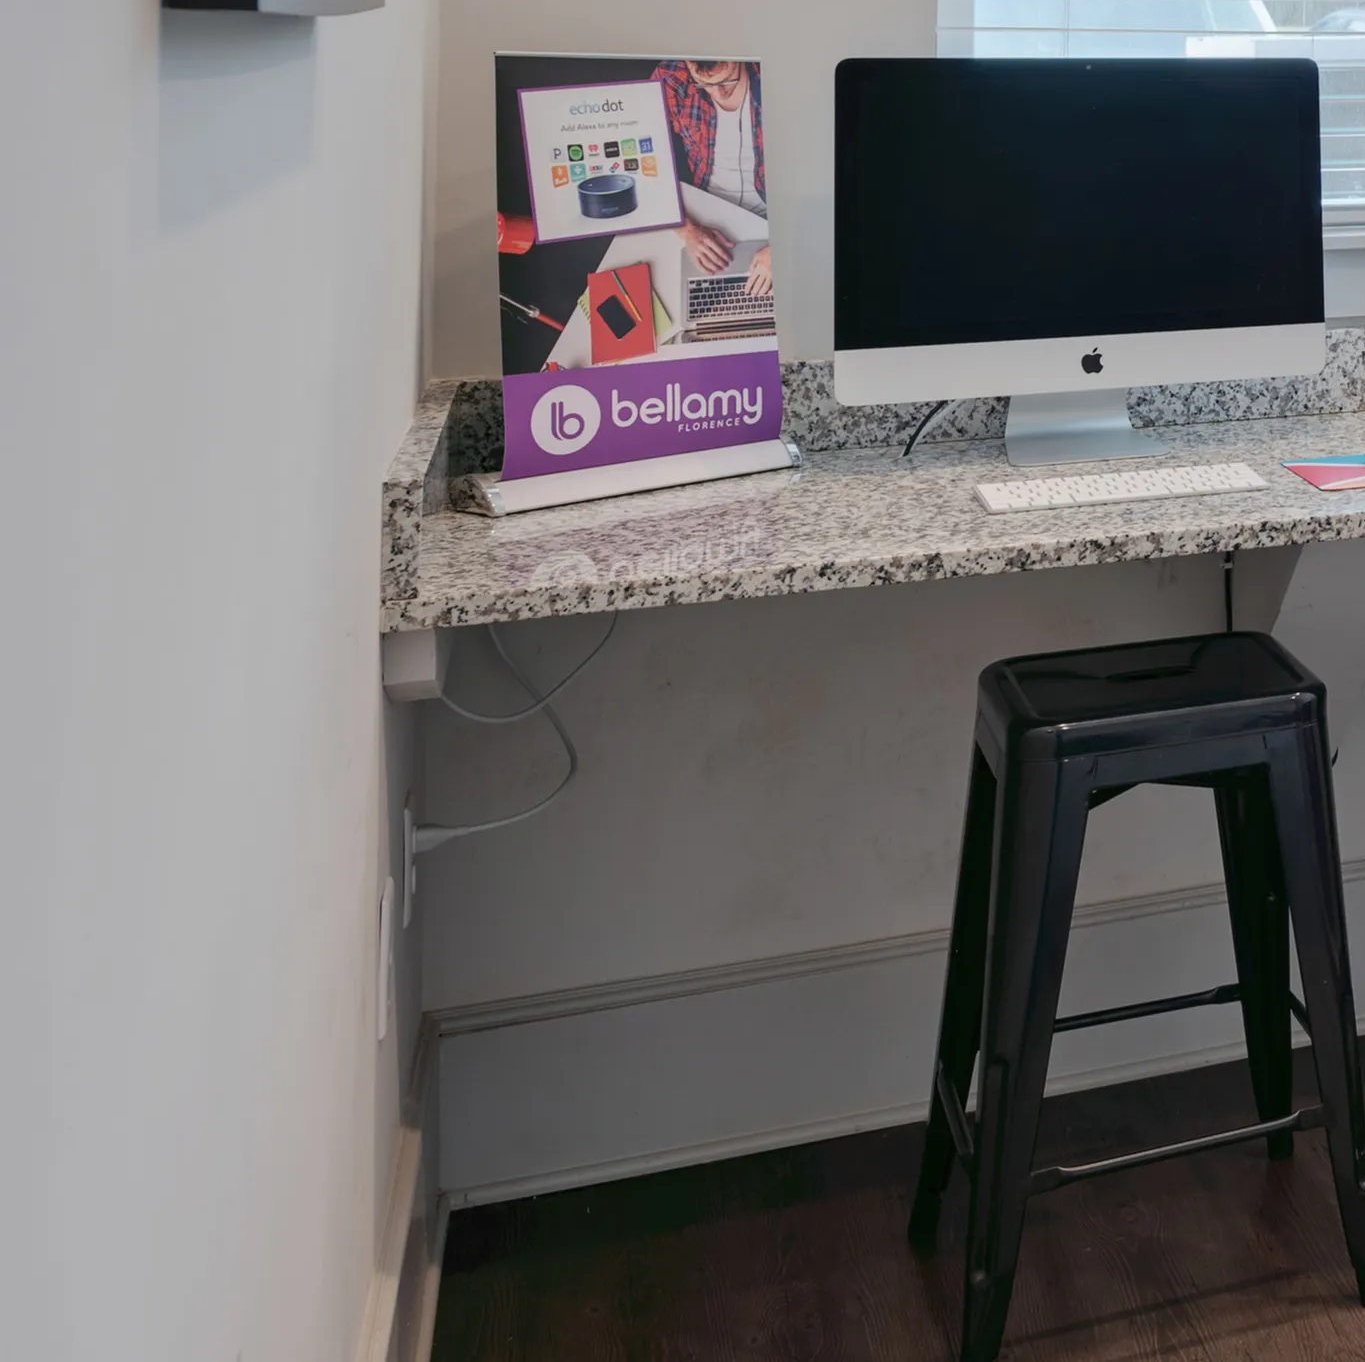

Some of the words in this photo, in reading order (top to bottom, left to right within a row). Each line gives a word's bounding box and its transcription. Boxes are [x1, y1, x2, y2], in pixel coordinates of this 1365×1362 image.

[569, 100, 600, 115] echo
[601, 98, 624, 112] dot
[641, 141, 651, 152] 31
[611, 382, 763, 428] bellamy
[677, 417, 741, 433] FLORENCE
